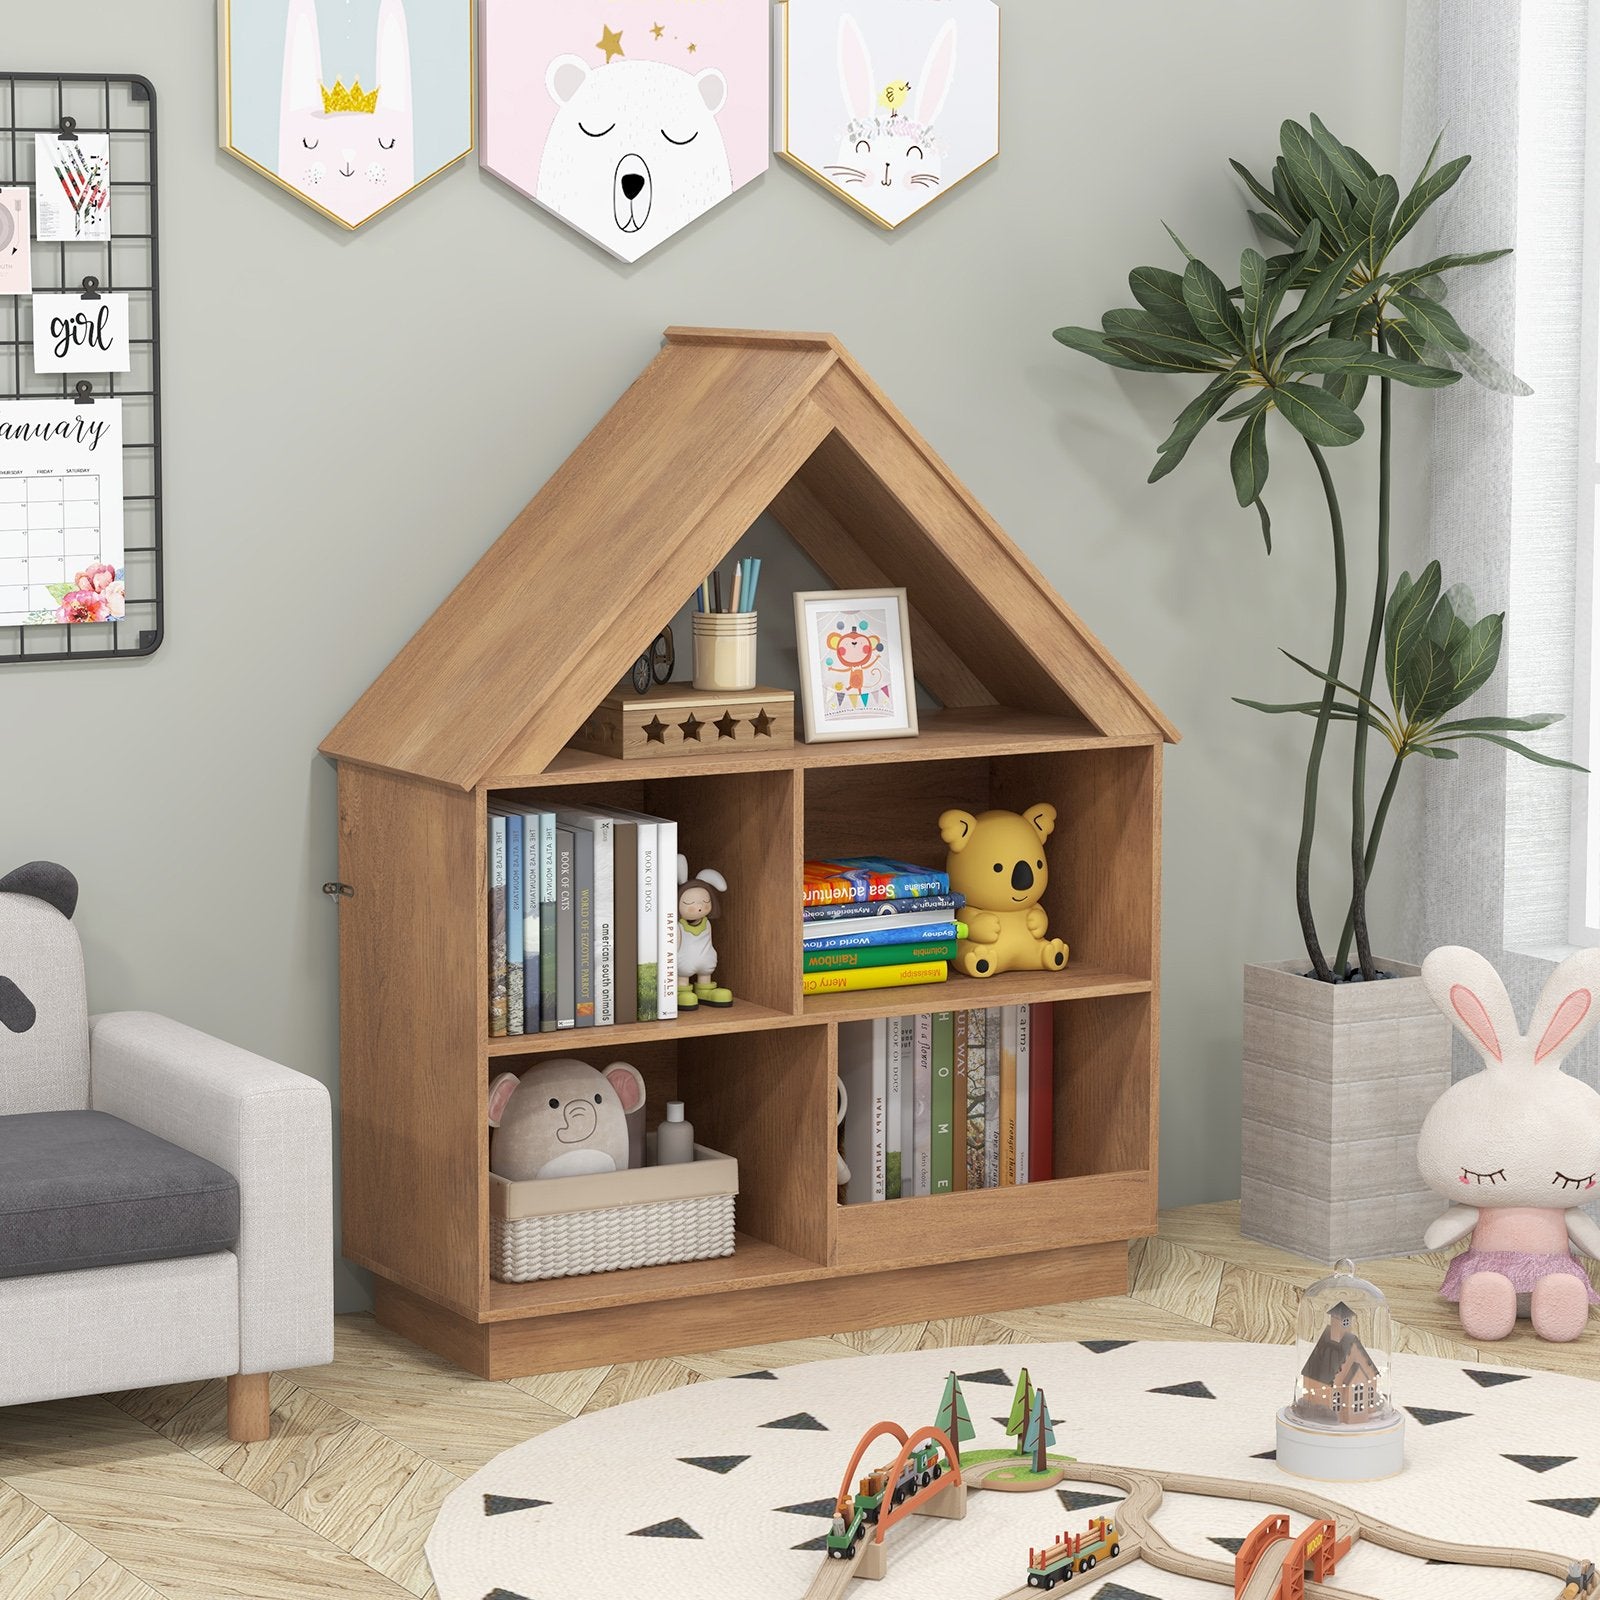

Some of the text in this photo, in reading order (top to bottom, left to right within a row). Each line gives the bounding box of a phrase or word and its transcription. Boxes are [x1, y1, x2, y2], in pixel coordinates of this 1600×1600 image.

[50, 304, 114, 358] girl
[0, 414, 111, 452] anuary
[560, 851, 570, 911] BOOK OF CATS
[644, 850, 653, 913] BOOK OF DOGS
[869, 883, 895, 897] Sea
[904, 881, 940, 892] Louisiana
[580, 889, 590, 918] WORLD
[580, 919, 590, 930] OF
[922, 930, 954, 938] Sydney
[666, 912, 674, 997] HAPPY ANIMALS
[824, 940, 836, 948] of
[839, 937, 870, 947] World
[913, 946, 948, 956] Columbia
[602, 923, 612, 1022] american south animals
[808, 954, 858, 967] Rainbow
[900, 968, 941, 979] Mississippi
[580, 968, 590, 998] PARROT
[819, 977, 847, 988] Merry
[918, 1040, 930, 1069] flower
[957, 1010, 966, 1077] UR WAY
[937, 1012, 949, 1188] HOME
[1008, 1118, 1016, 1154] stronger
[1008, 1157, 1016, 1177] than
